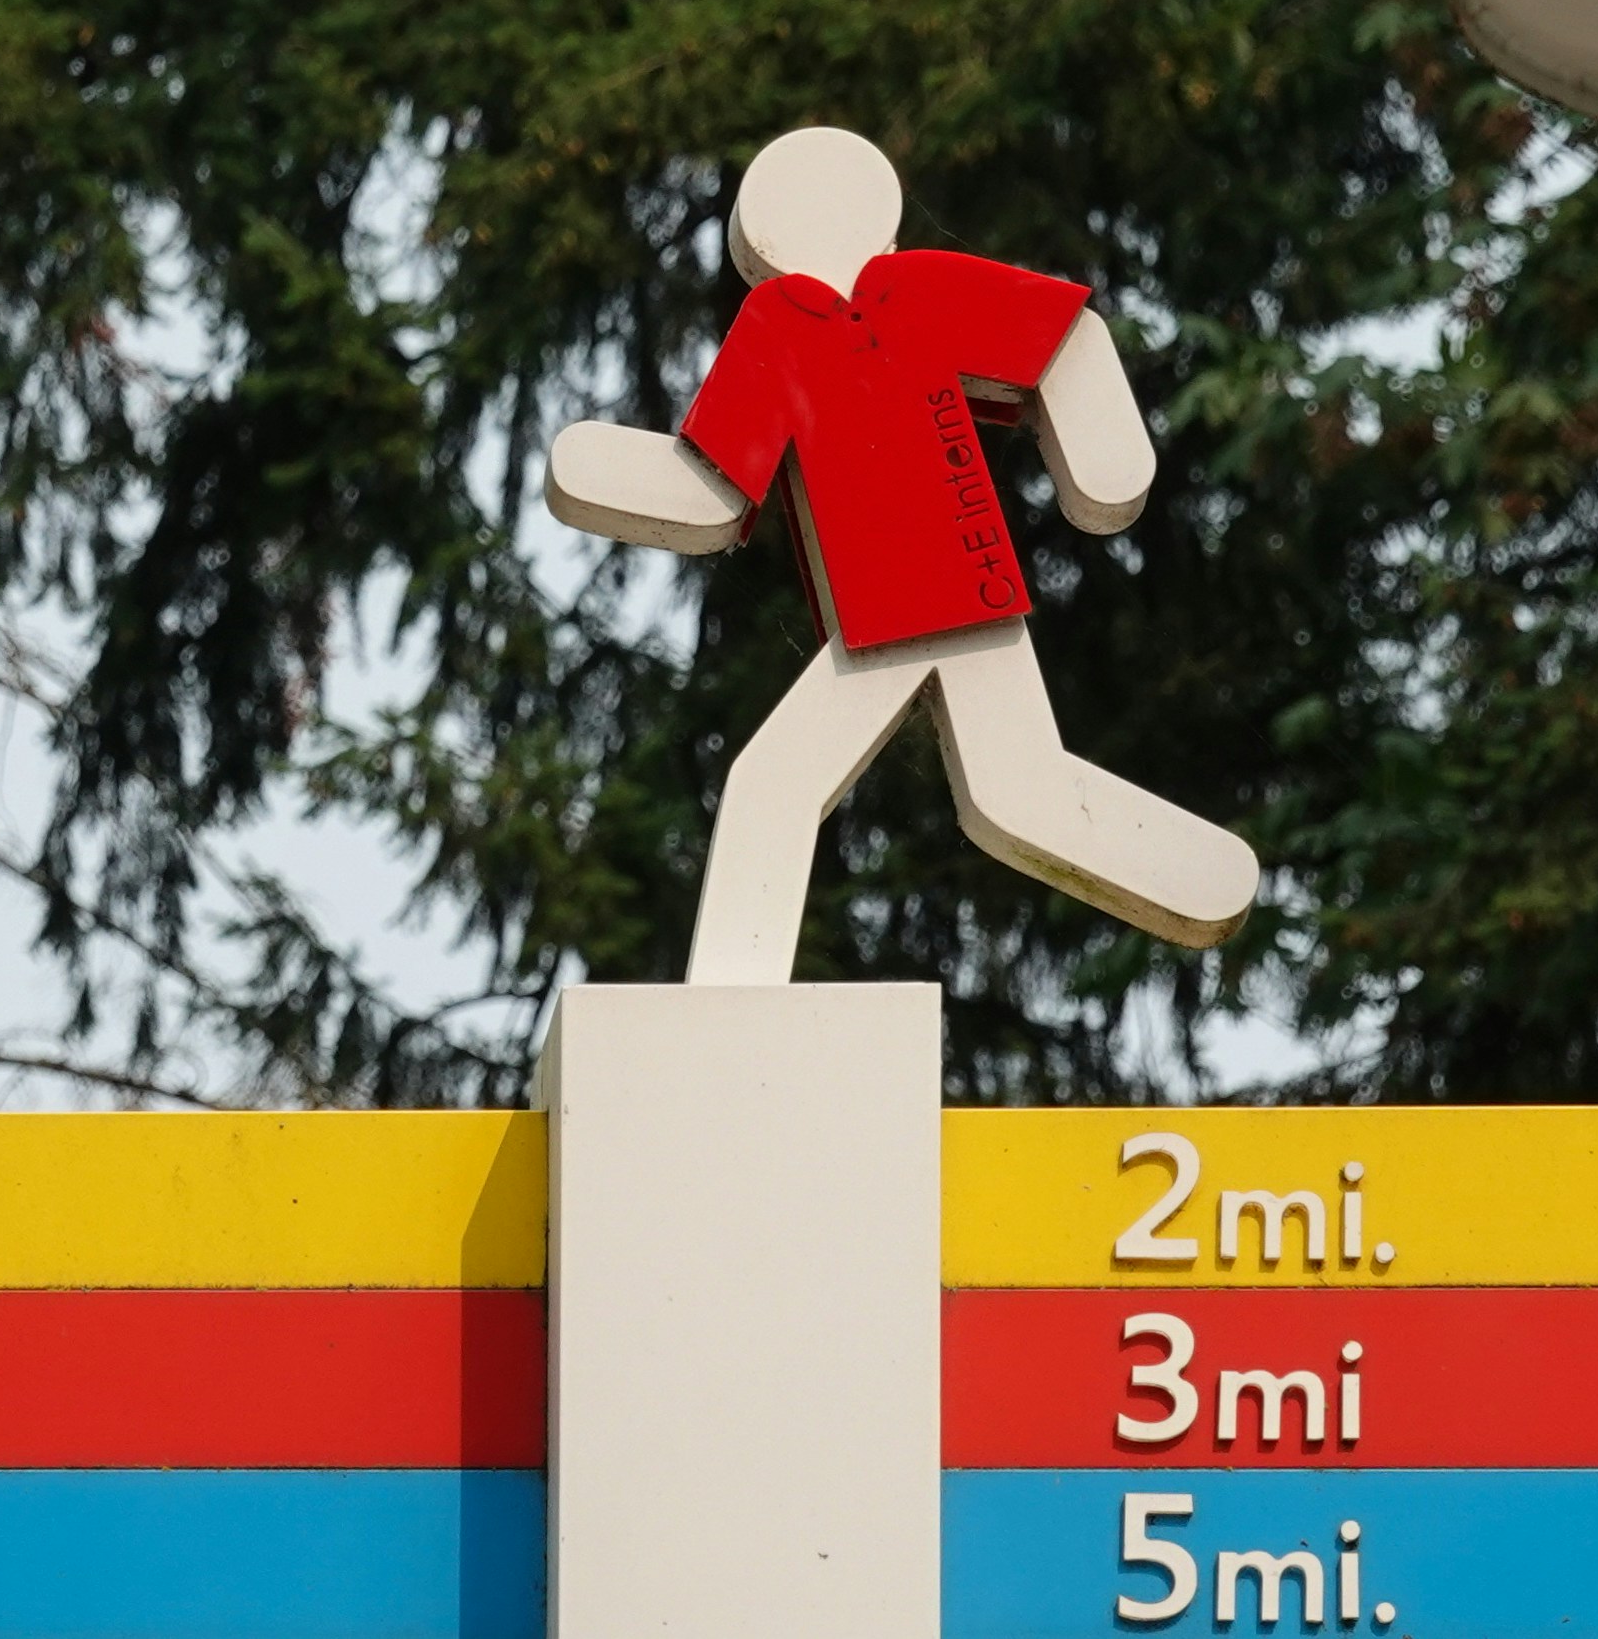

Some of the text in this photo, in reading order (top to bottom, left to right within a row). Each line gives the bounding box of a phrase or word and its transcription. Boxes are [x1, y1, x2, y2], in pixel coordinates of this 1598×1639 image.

[927, 388, 1016, 610] C+E interns
[1116, 1312, 1364, 1442] 3mi
